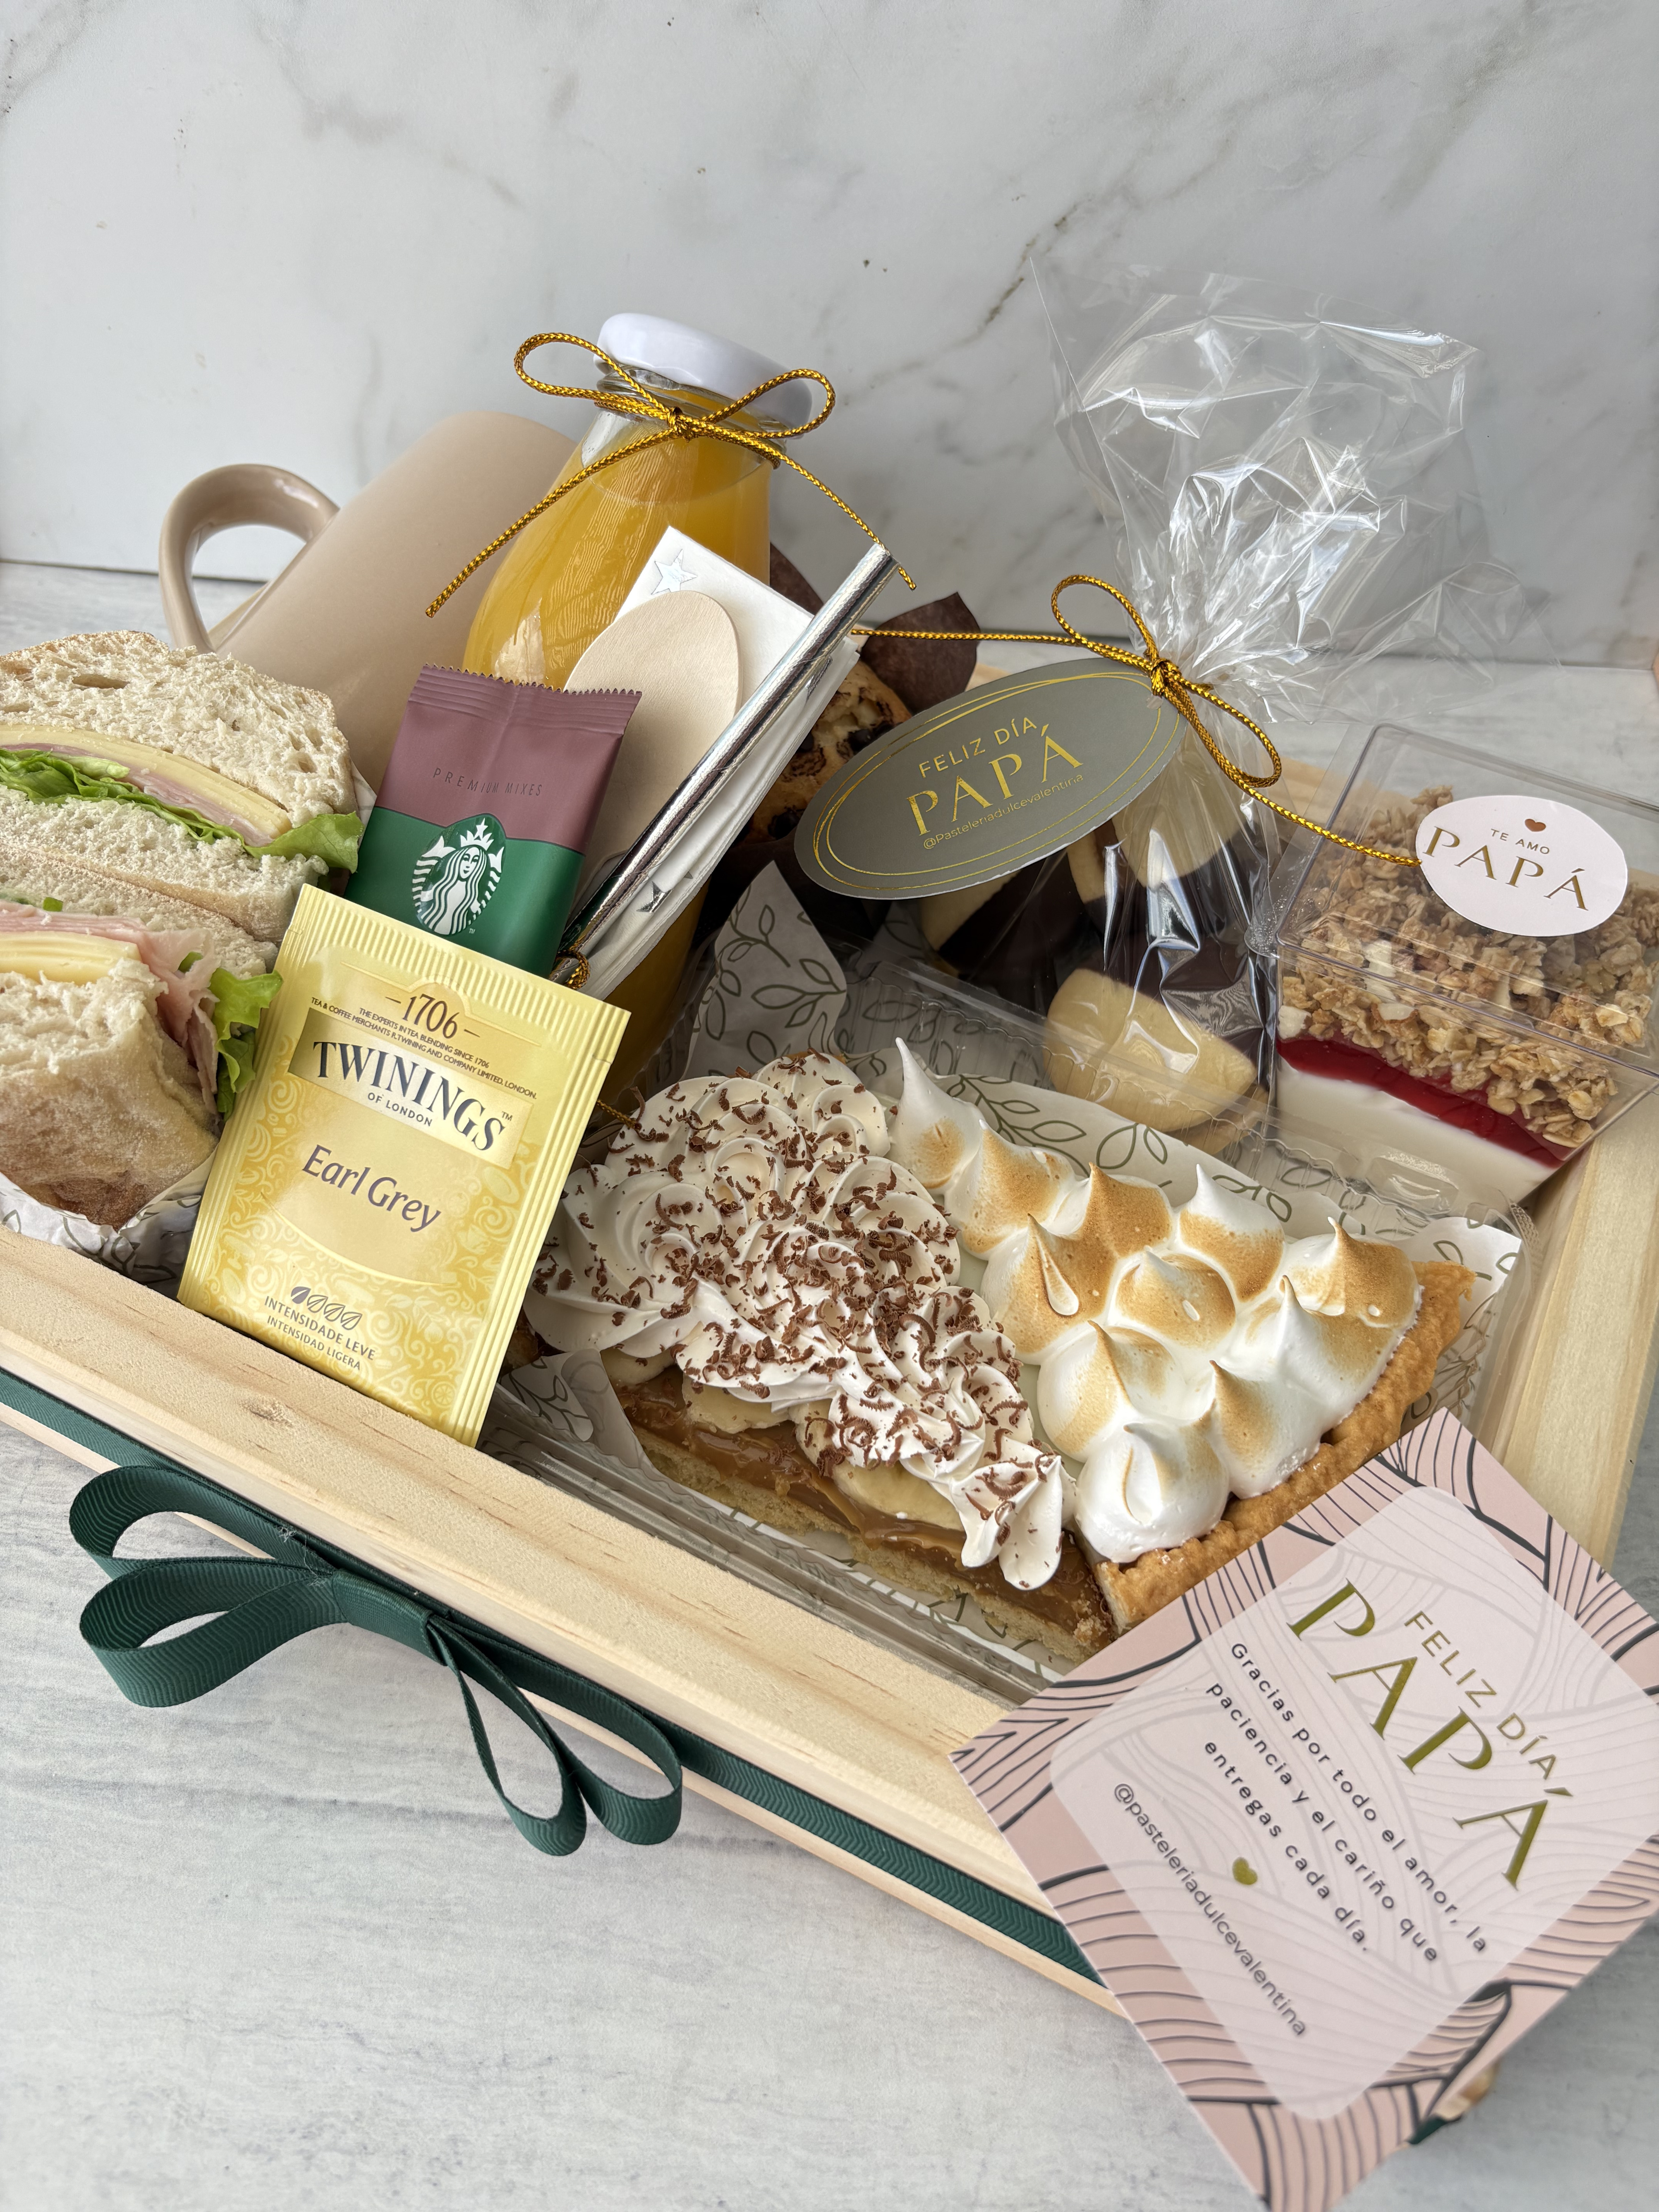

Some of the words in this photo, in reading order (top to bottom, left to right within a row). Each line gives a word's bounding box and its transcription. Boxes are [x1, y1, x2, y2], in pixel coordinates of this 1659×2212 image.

[433, 768, 499, 793] PREMIUM
[505, 783, 542, 796] MIXES
[906, 724, 1084, 836] PAPÁ
[919, 738, 986, 778] FELIZ
[994, 717, 1037, 745] DÍA
[1422, 826, 1589, 910] PAPÁ
[1491, 828, 1509, 841] TE
[1515, 839, 1549, 854] AMO
[312, 997, 322, 1007] TEA
[329, 1005, 351, 1019] COFFEE
[352, 1015, 391, 1036] MERCHANTS
[426, 1048, 442, 1058] AND
[444, 1054, 477, 1072] COMPANY
[505, 1080, 537, 1099] LONDON.
[359, 1008, 372, 1018] THE
[372, 1014, 398, 1029] EXPERTS
[399, 1025, 407, 1033] IN
[408, 1028, 418, 1039] TEA
[420, 1034, 453, 1053] BLENDING
[453, 1049, 473, 1061] SINCE
[475, 1058, 489, 1068] 1706
[313, 1041, 505, 1151] TWININGS
[368, 1092, 383, 1103] OF
[386, 1100, 433, 1127] LONDON
[302, 1144, 371, 1195] Earl
[368, 1177, 441, 1232] Grey
[264, 1296, 343, 1344] INTENSIDADE
[345, 1338, 376, 1360] LEVE
[267, 1316, 324, 1351] INTENSIDAD
[327, 1347, 361, 1370] LIGERA
[1286, 1578, 1574, 1891] PAPÁ
[1404, 1610, 1497, 1709] FELIZ
[1496, 1712, 1556, 1780] DÍA
[1206, 1683, 1293, 1785] paciencia
[1292, 1790, 1310, 1803] y
[1312, 1811, 1335, 1832] el
[1334, 1839, 1395, 1909] cariño
[1400, 1918, 1437, 1961] que
[1231, 1643, 1294, 1722] Gracias
[1292, 1727, 1330, 1763] por
[1333, 1769, 1377, 1821] todo
[1382, 1829, 1406, 1850] el
[1405, 1857, 1458, 1923] amor,
[1467, 1926, 1486, 1952] la
[1204, 1742, 1282, 1837] entregas
[1285, 1844, 1330, 1899] cada
[1334, 1907, 1367, 1951] día.
[1114, 1783, 1306, 2036] @pasteleriadulcevalentina
